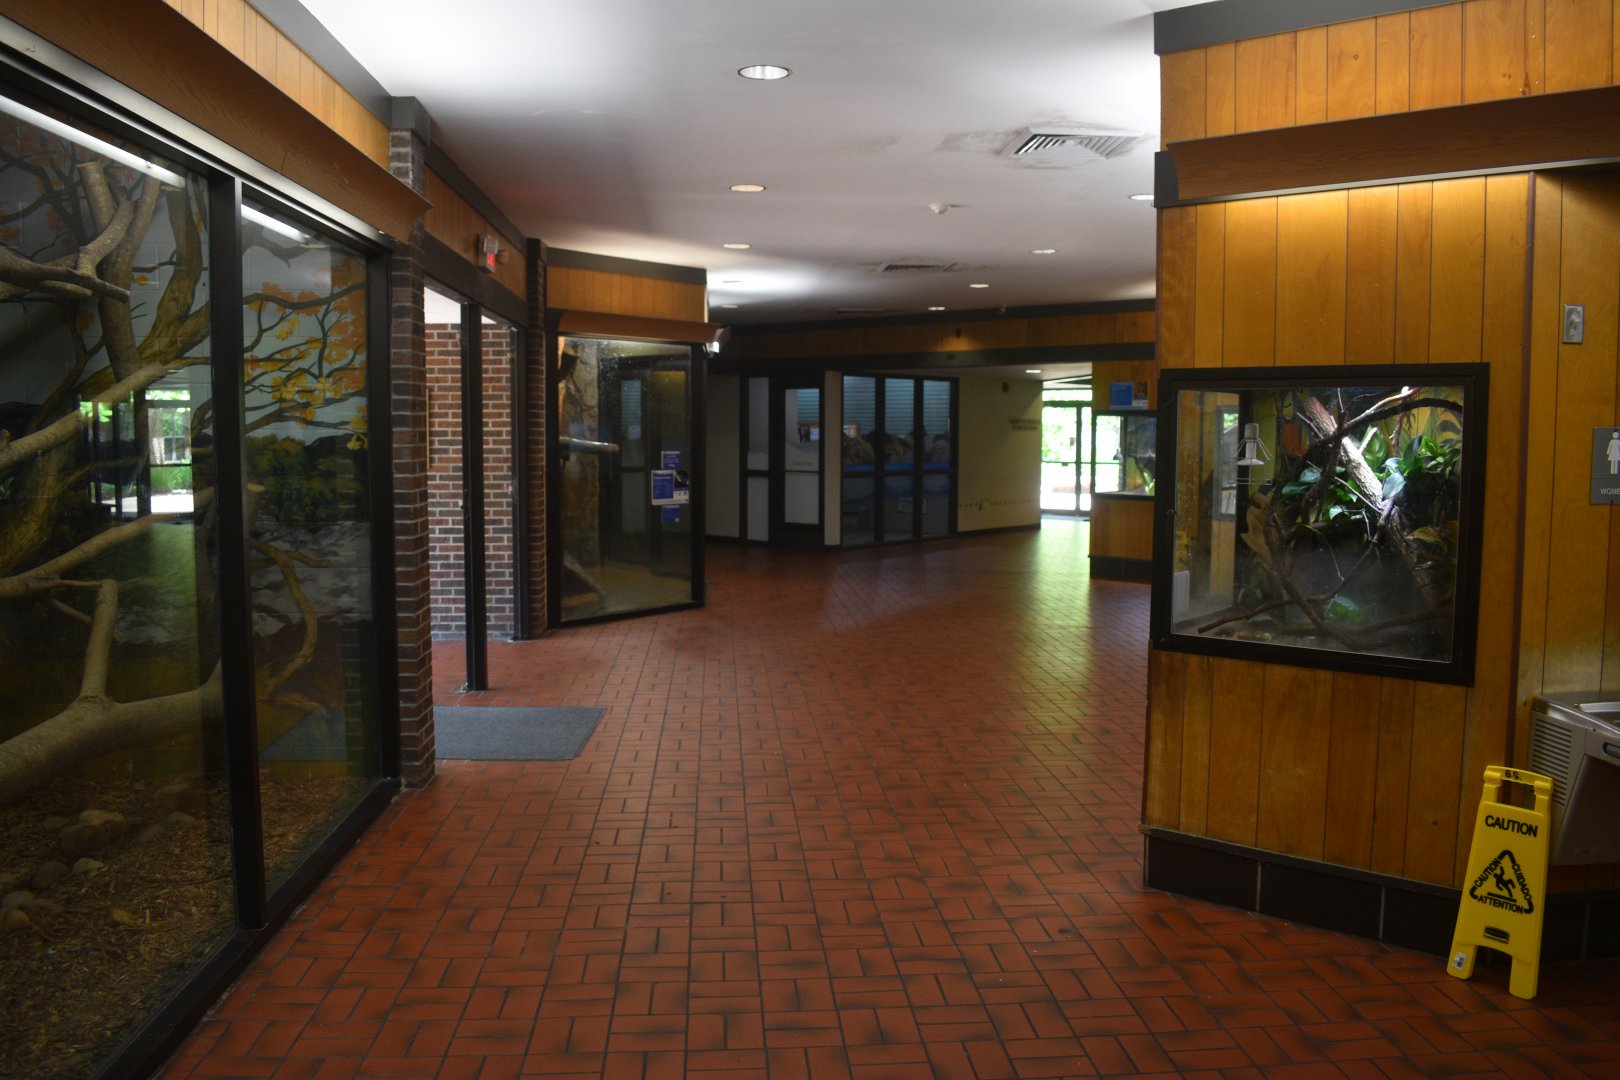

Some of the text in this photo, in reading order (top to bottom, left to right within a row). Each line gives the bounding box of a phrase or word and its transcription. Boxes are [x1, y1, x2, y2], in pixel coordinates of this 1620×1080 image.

[1485, 815, 1538, 837] CAUTION
[1474, 858, 1501, 887] CAUTION
[1512, 863, 1532, 902] CUIDADO
[1478, 895, 1524, 914] ATTENTION
